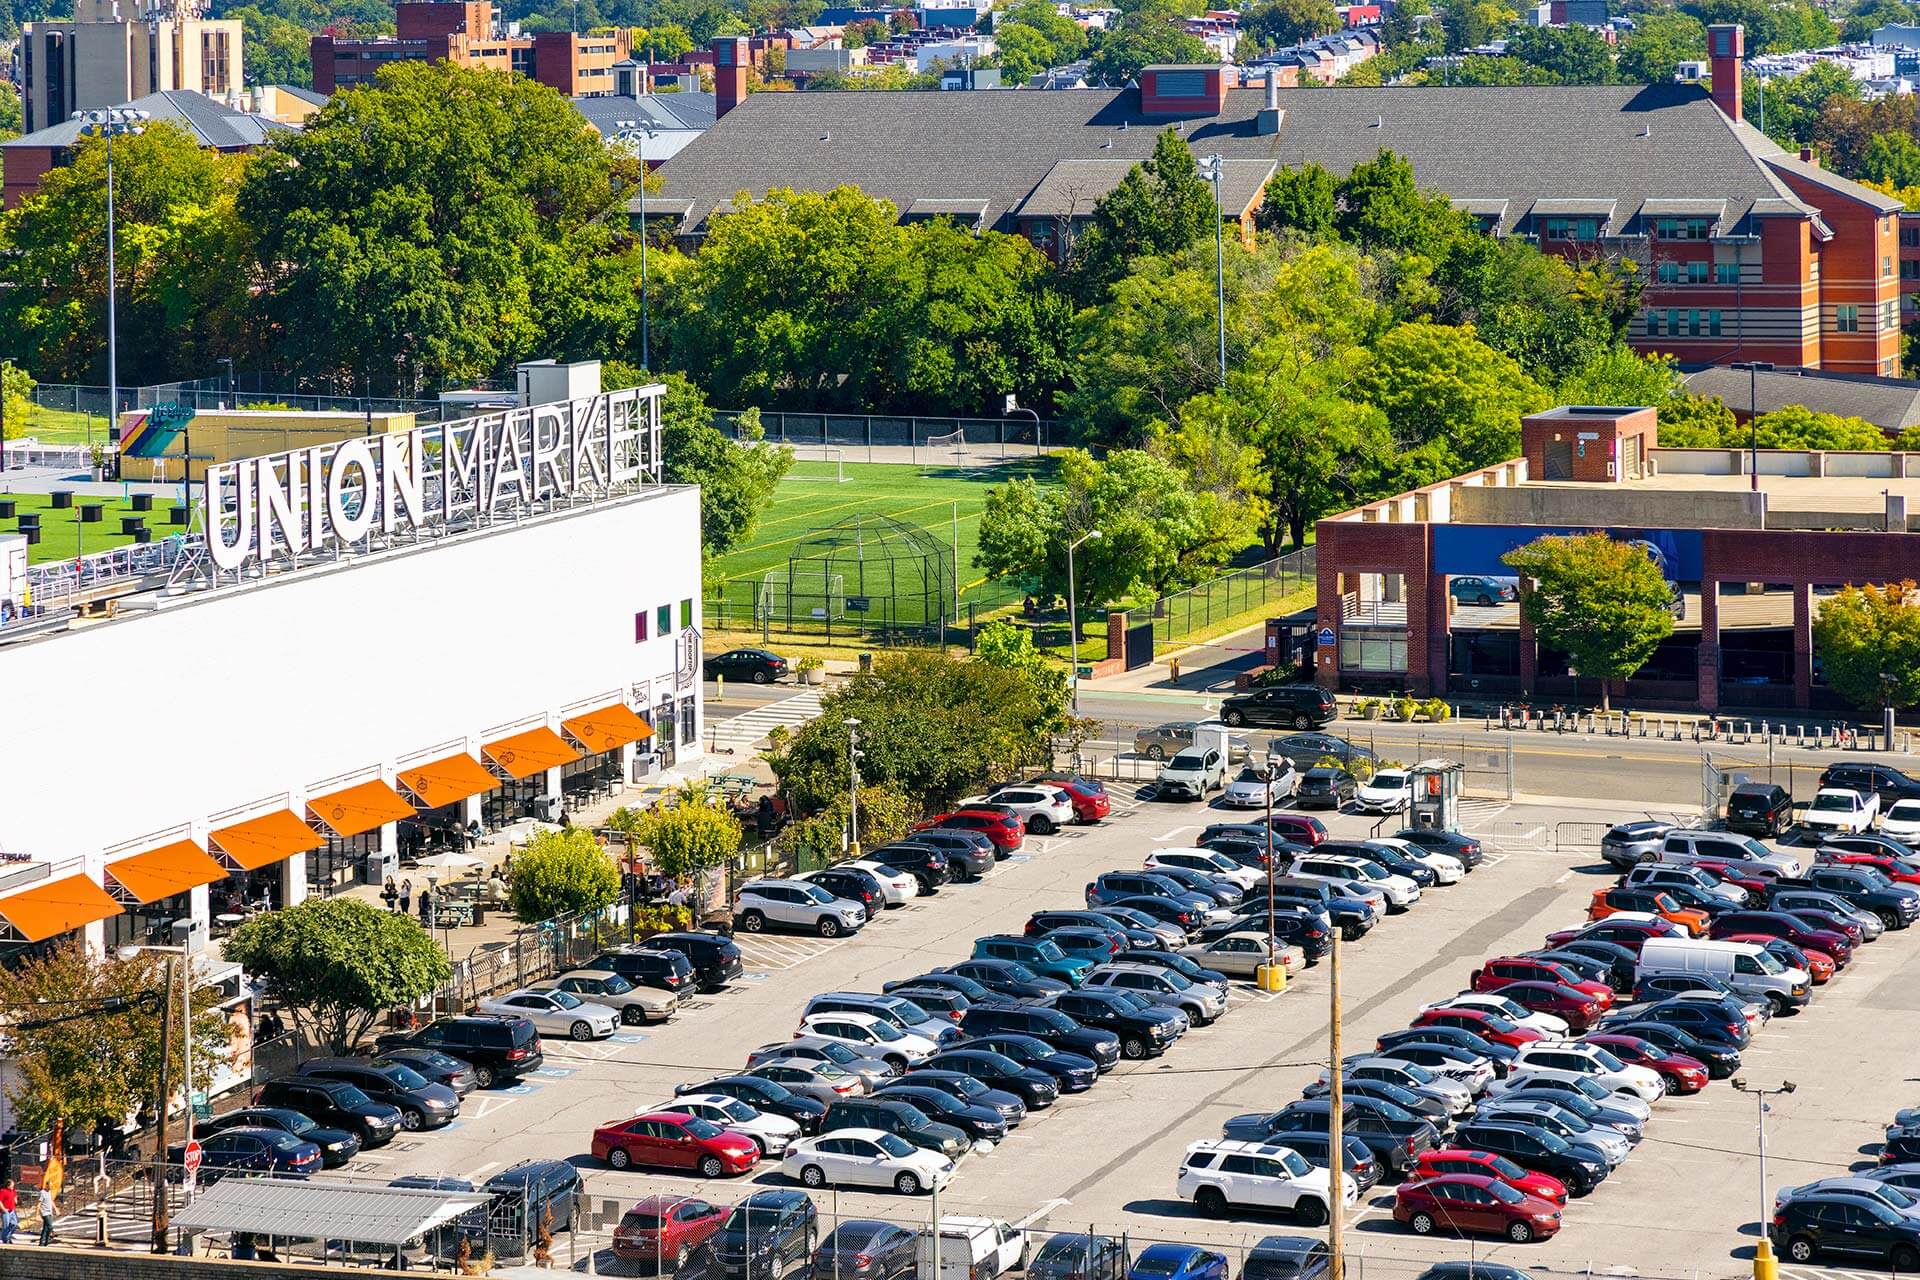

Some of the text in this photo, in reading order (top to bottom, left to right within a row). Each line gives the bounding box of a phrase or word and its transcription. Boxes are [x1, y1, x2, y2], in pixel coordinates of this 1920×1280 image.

[205, 384, 667, 570] UNION MARKET
[186, 1150, 200, 1163] STOP
